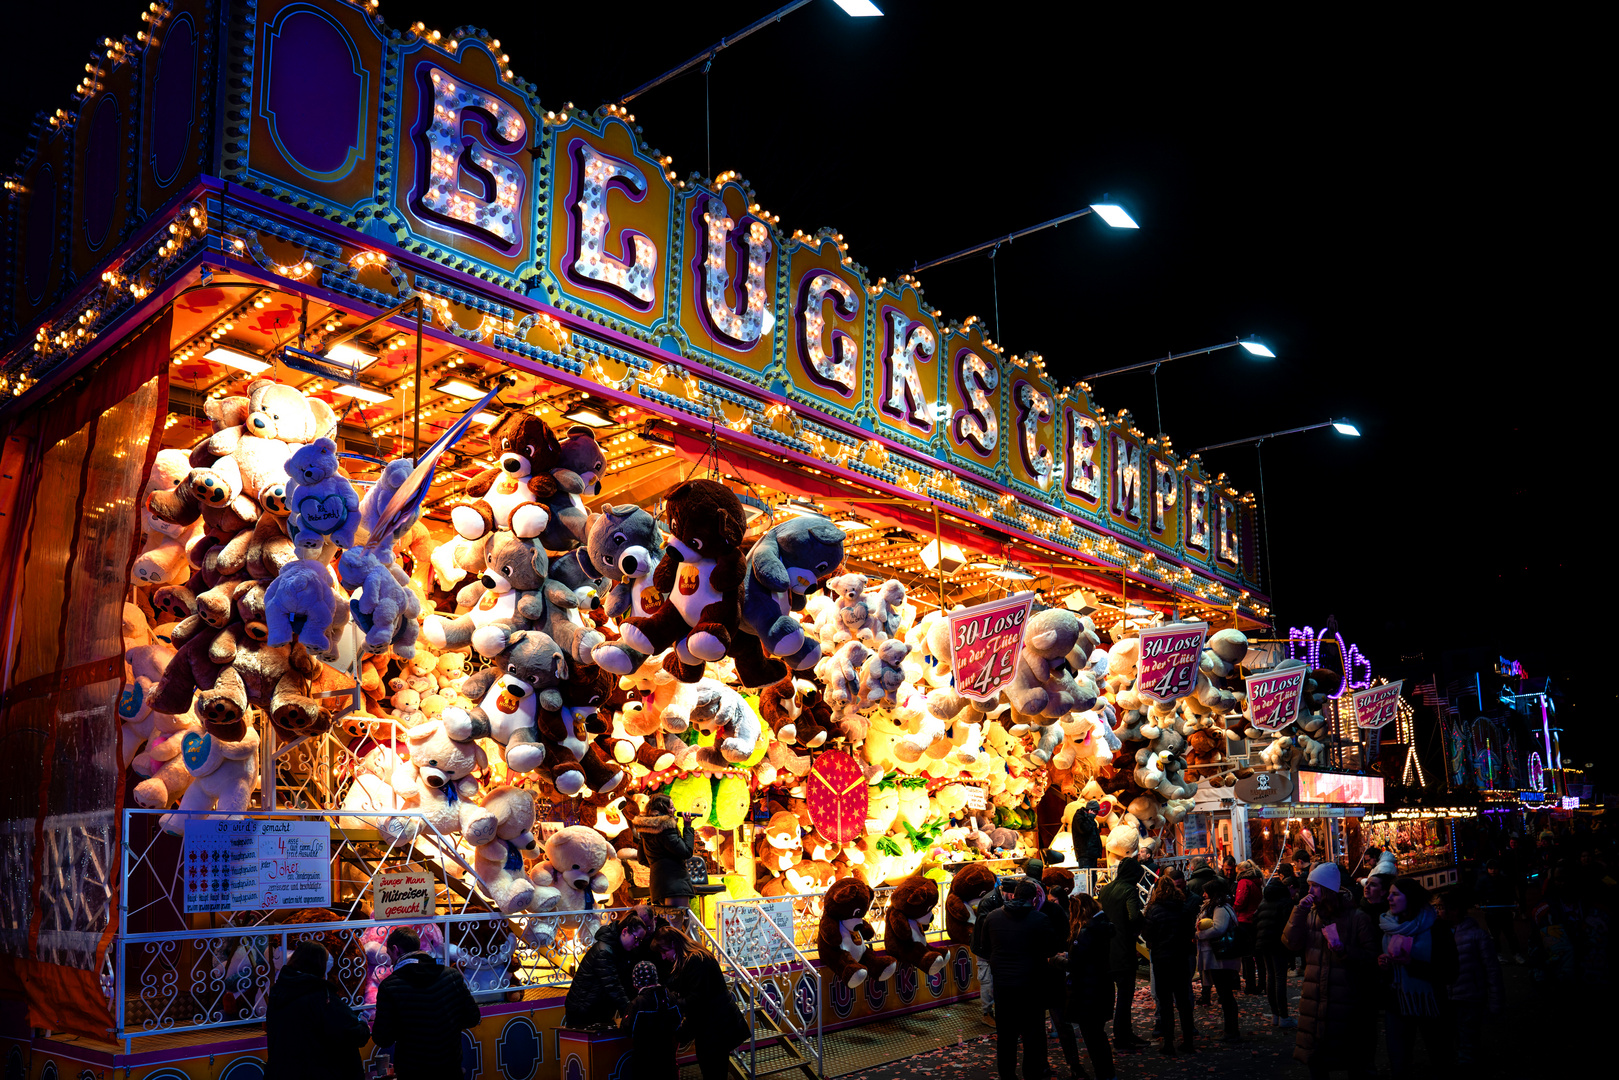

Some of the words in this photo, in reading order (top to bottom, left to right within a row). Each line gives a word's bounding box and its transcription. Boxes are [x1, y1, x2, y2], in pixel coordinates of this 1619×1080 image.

[644, 600, 662, 610] Honey
[955, 620, 979, 651] 30
[980, 608, 1025, 640] Lose
[958, 658, 966, 670] in
[969, 648, 986, 664] der
[986, 632, 1020, 654] Tüte
[1142, 638, 1163, 660] 30
[1162, 635, 1200, 654] Lose
[1142, 665, 1150, 674] in
[1152, 660, 1166, 671] der
[1167, 653, 1196, 667] Tüte
[960, 672, 976, 690] nur
[1140, 679, 1156, 690] nur
[1251, 682, 1268, 701] 30
[1269, 676, 1300, 694] Lose
[1262, 700, 1274, 708] der
[1274, 690, 1297, 702] Tüte
[1358, 696, 1371, 710] 30
[1372, 688, 1398, 704] Lose
[1255, 714, 1268, 726] nur
[188, 746, 202, 754] LOVE
[218, 822, 228, 832] So
[262, 823, 290, 834] gemacht
[278, 837, 286, 854] 4
[268, 860, 298, 880] Joker
[380, 877, 404, 888] Junger
[405, 876, 426, 884] Mann
[381, 887, 428, 904] Mitreisen
